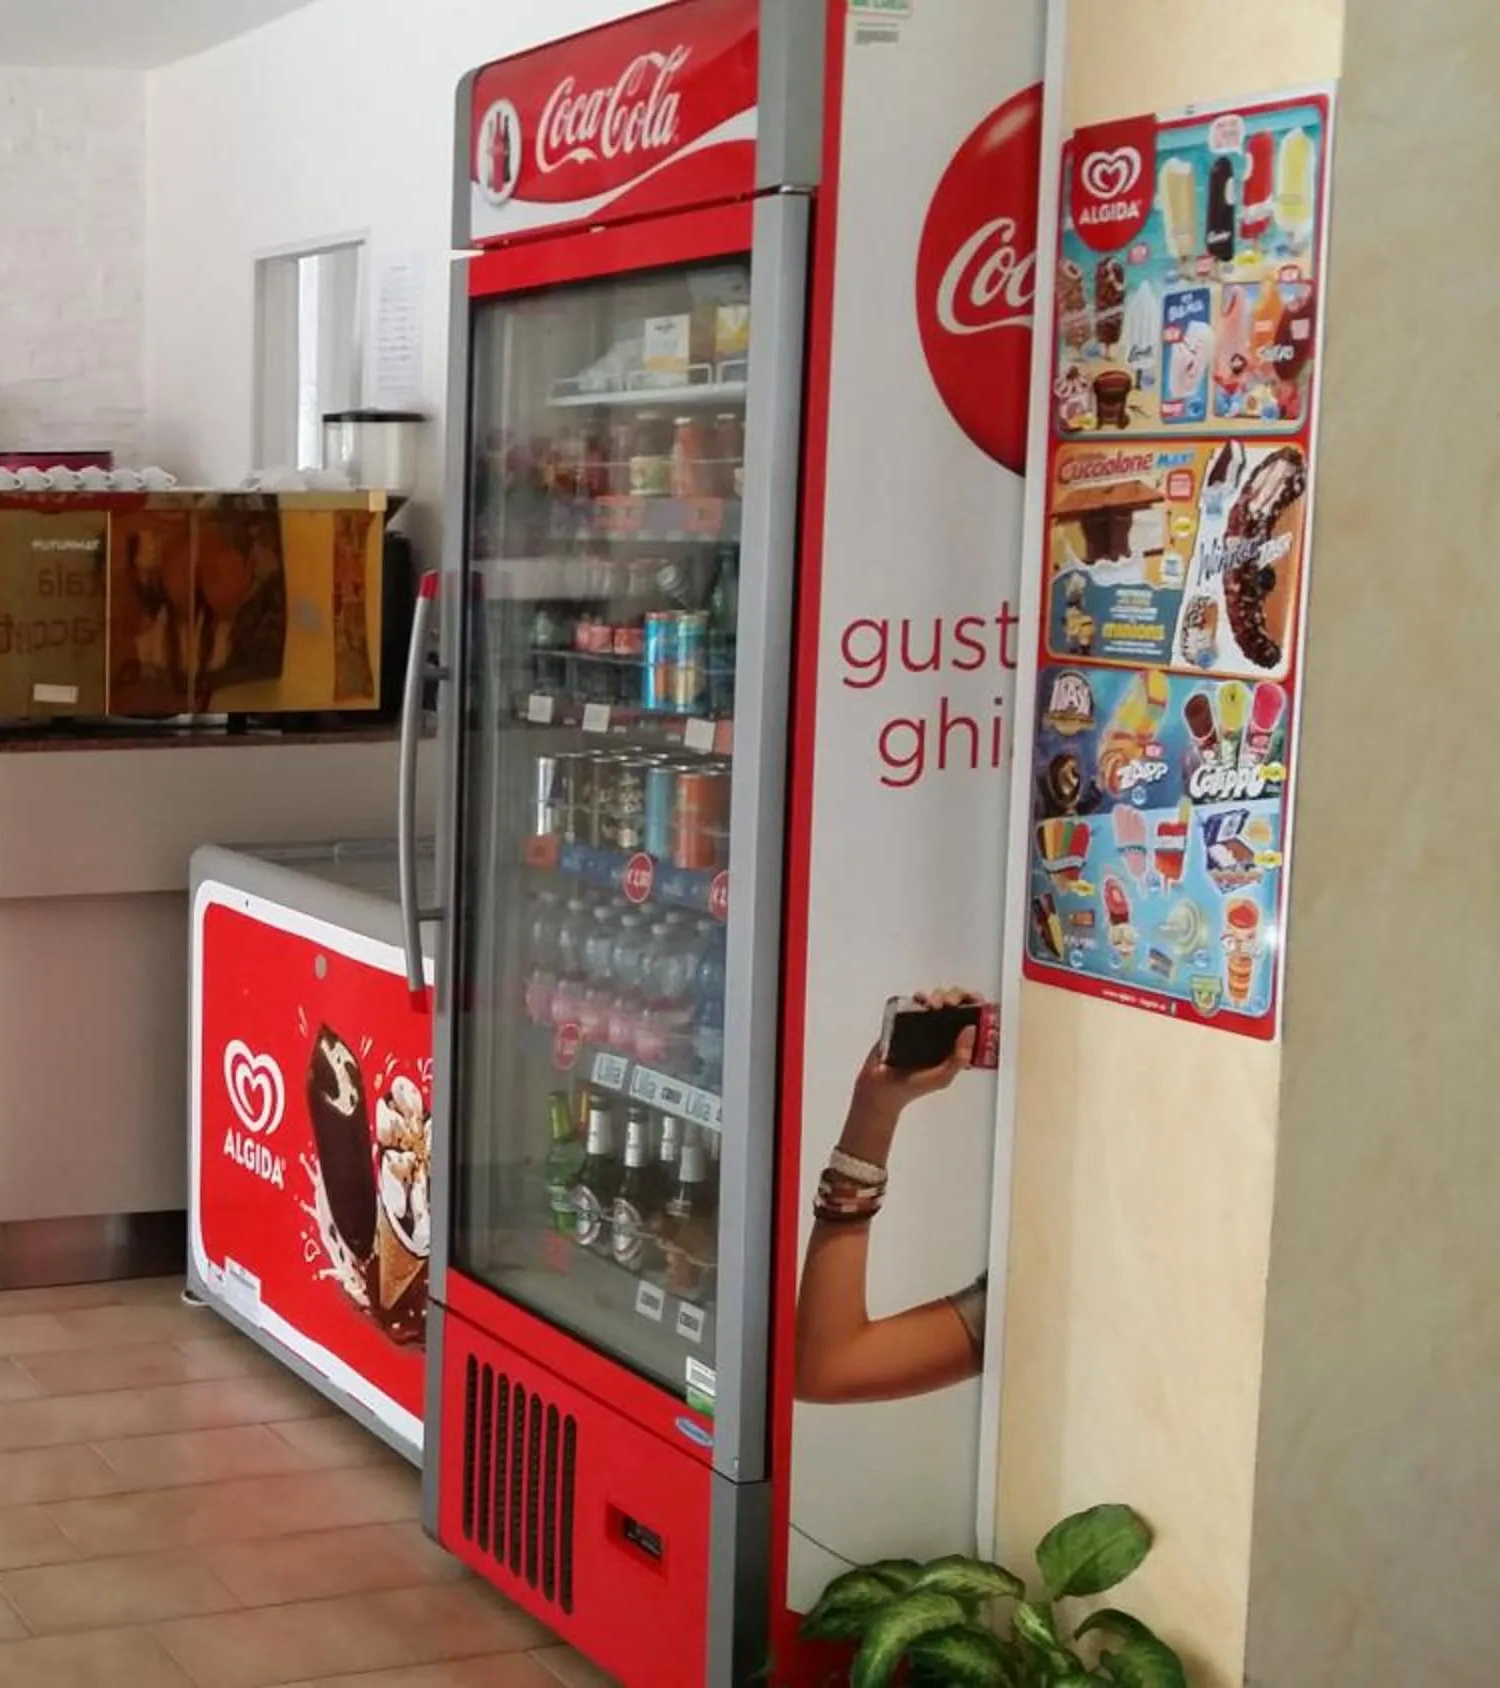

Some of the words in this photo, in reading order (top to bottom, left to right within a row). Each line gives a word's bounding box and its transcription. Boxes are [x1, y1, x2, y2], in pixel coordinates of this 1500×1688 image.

[1079, 200, 1140, 225] ALGIDA
[841, 601, 1019, 689] gust
[879, 697, 1003, 788] ghi
[223, 1126, 285, 1191] ALGIDA
